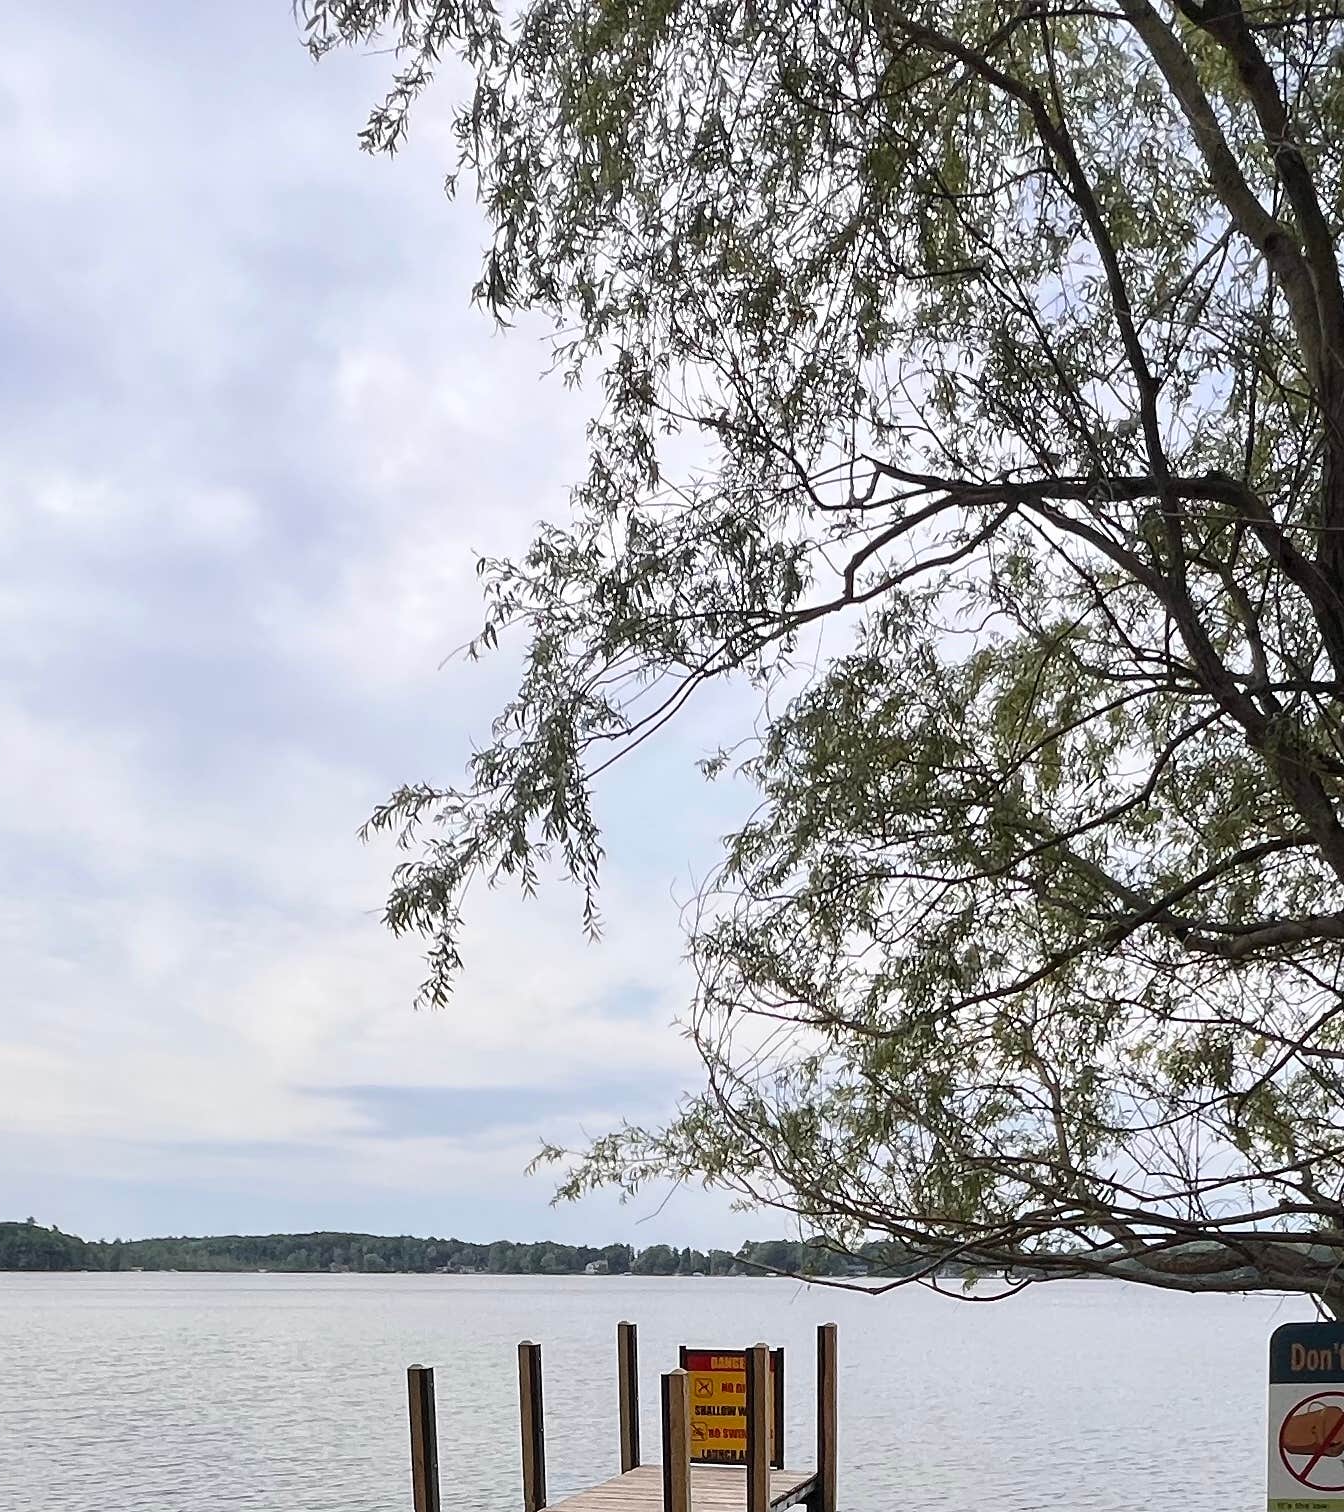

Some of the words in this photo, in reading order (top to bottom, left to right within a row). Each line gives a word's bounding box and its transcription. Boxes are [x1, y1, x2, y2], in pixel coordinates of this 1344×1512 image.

[711, 1357, 746, 1370] DANGE
[722, 1383, 734, 1393] NO
[695, 1405, 736, 1416] SHALLOW
[708, 1428, 721, 1438] NO
